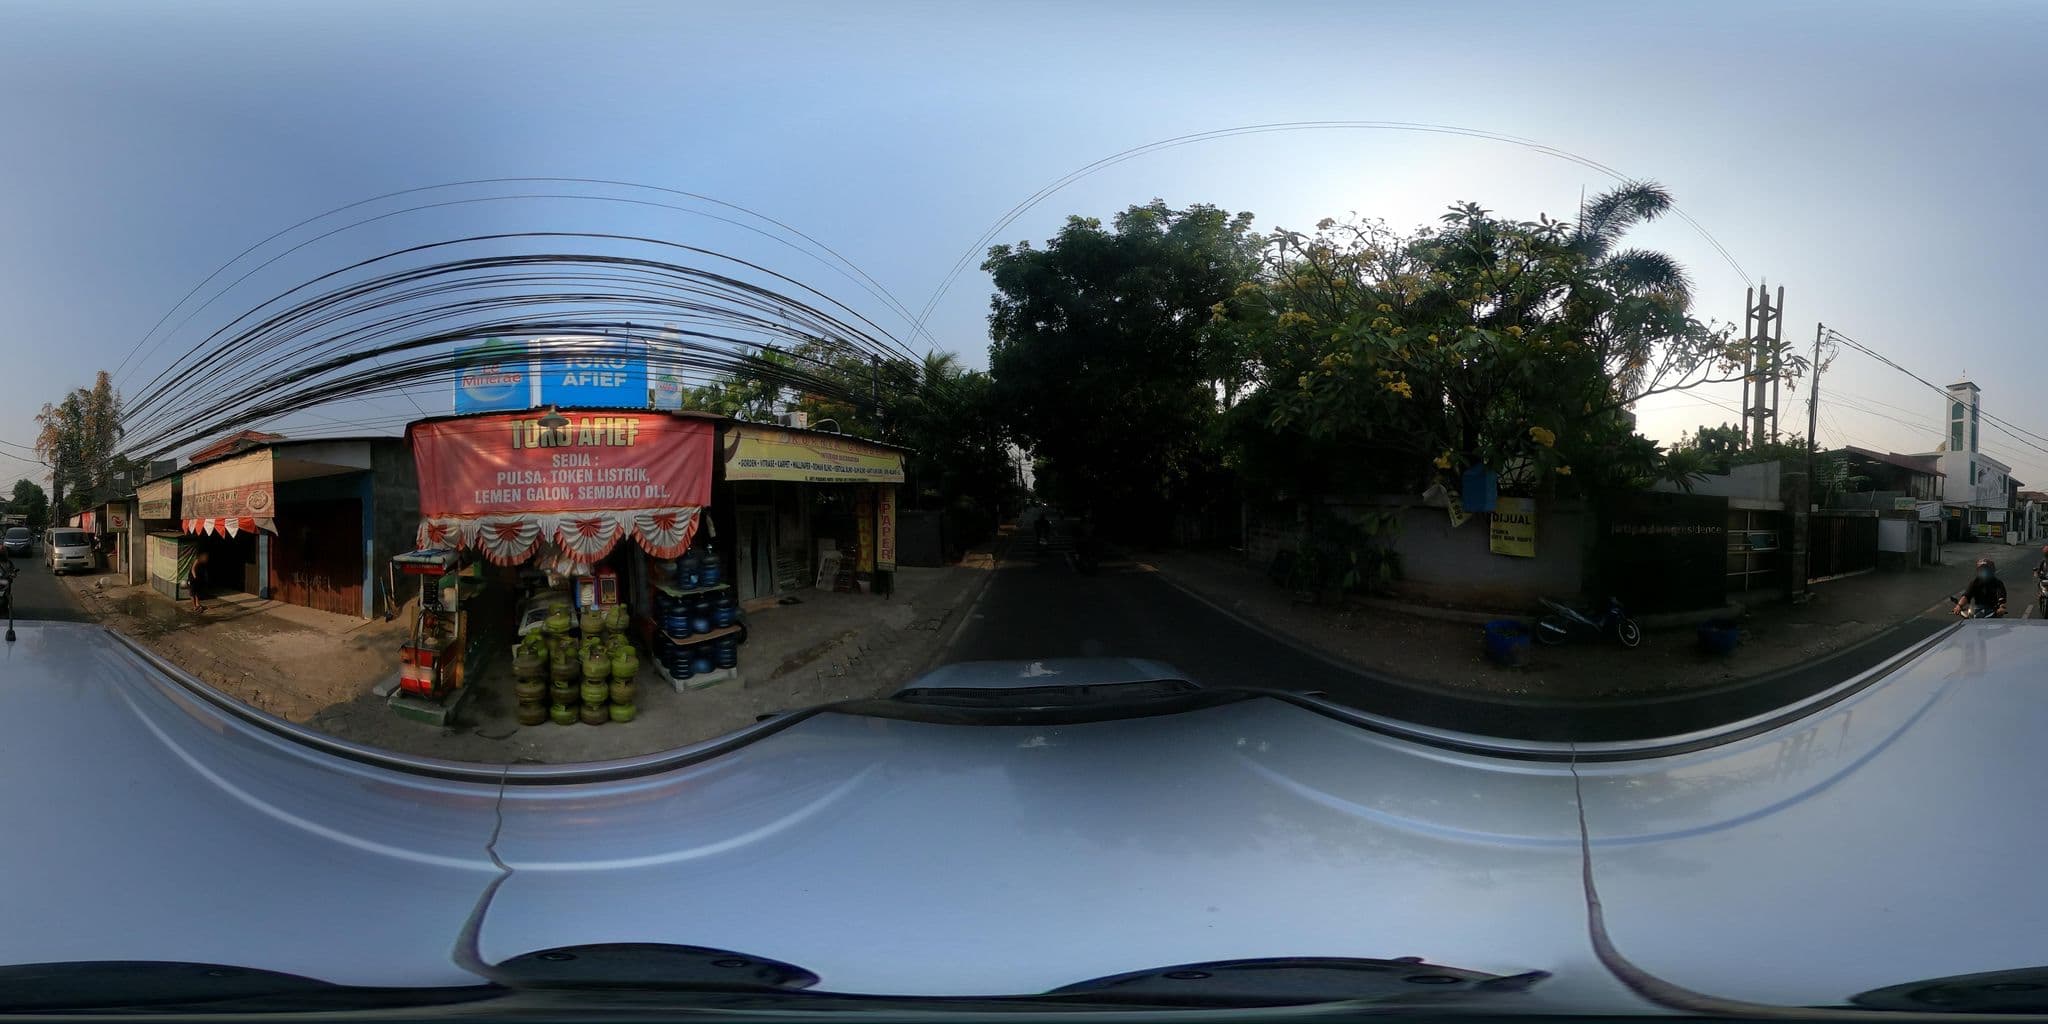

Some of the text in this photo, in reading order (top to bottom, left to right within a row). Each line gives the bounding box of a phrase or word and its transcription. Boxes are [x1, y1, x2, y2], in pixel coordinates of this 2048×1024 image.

[563, 372, 627, 388] AFIEF
[577, 416, 641, 448] AFIEF
[552, 453, 591, 468] SEDIA
[497, 467, 651, 485] PULSA, TOKEN LISTRIK,
[526, 487, 574, 502] GALON,
[578, 485, 641, 500] SEMBAKO
[645, 484, 671, 499] DLL.
[1492, 512, 1531, 525] DIJUAL
